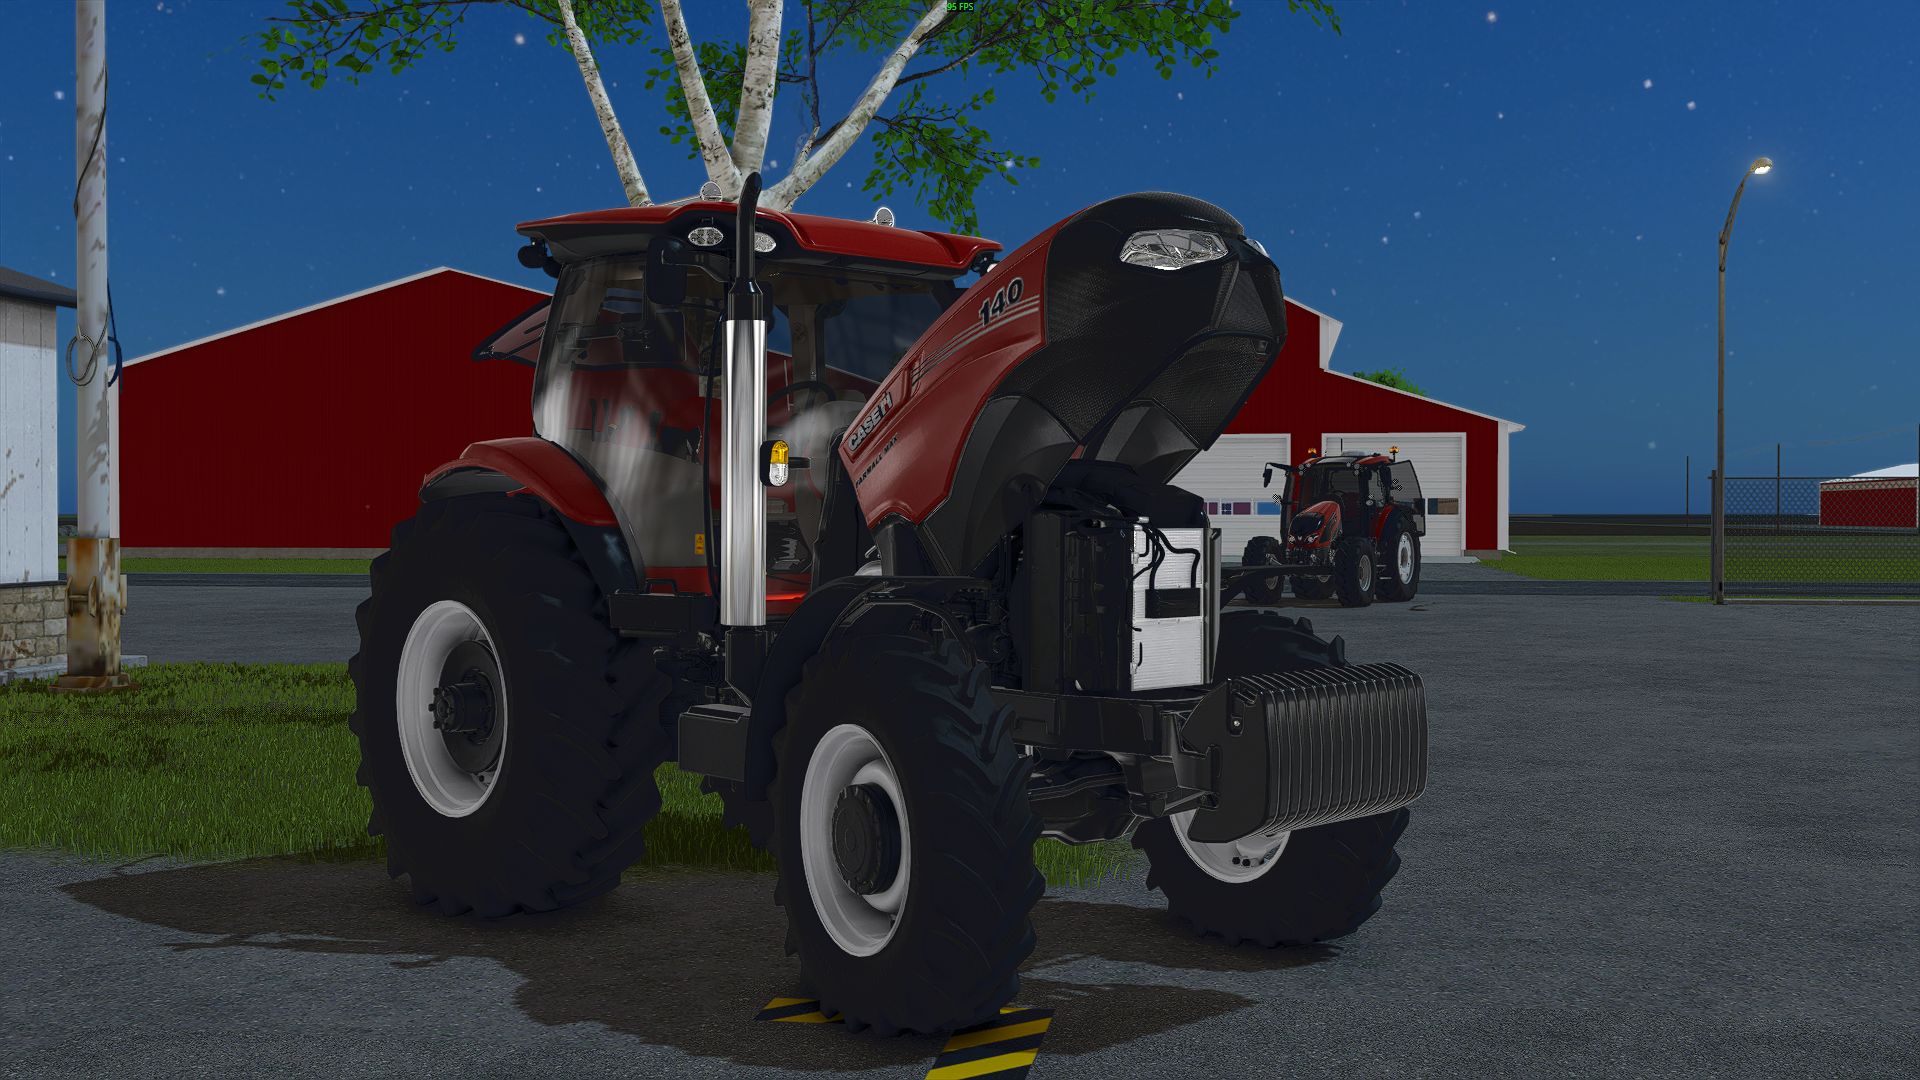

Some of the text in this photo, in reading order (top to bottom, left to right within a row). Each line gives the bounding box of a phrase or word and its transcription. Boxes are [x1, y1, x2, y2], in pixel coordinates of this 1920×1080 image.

[979, 277, 1024, 326] 140
[855, 435, 898, 488] FARMALL MAX
